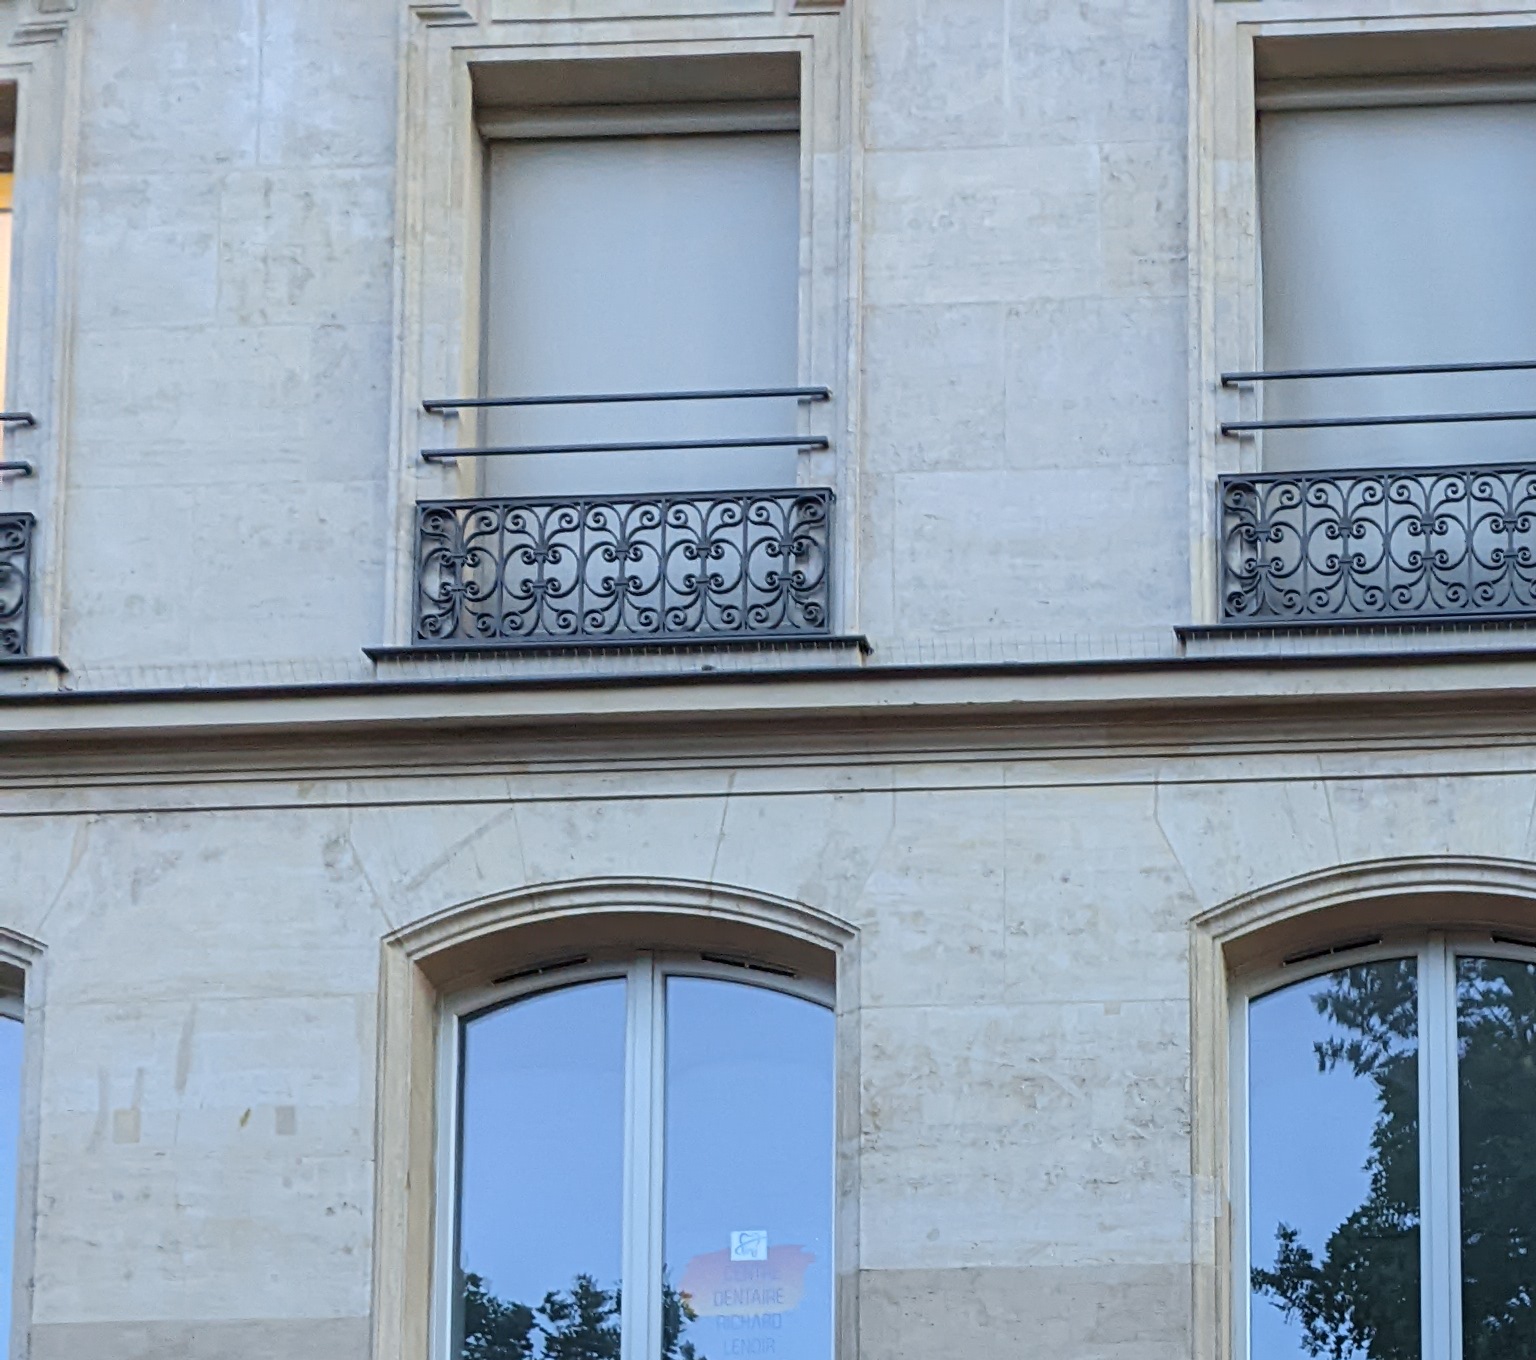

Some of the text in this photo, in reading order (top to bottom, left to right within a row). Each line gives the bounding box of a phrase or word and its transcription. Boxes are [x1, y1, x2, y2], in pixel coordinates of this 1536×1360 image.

[713, 1287, 786, 1307] DENTAIRE
[716, 1312, 783, 1330] RICHARD
[723, 1337, 776, 1356] LENOIR
